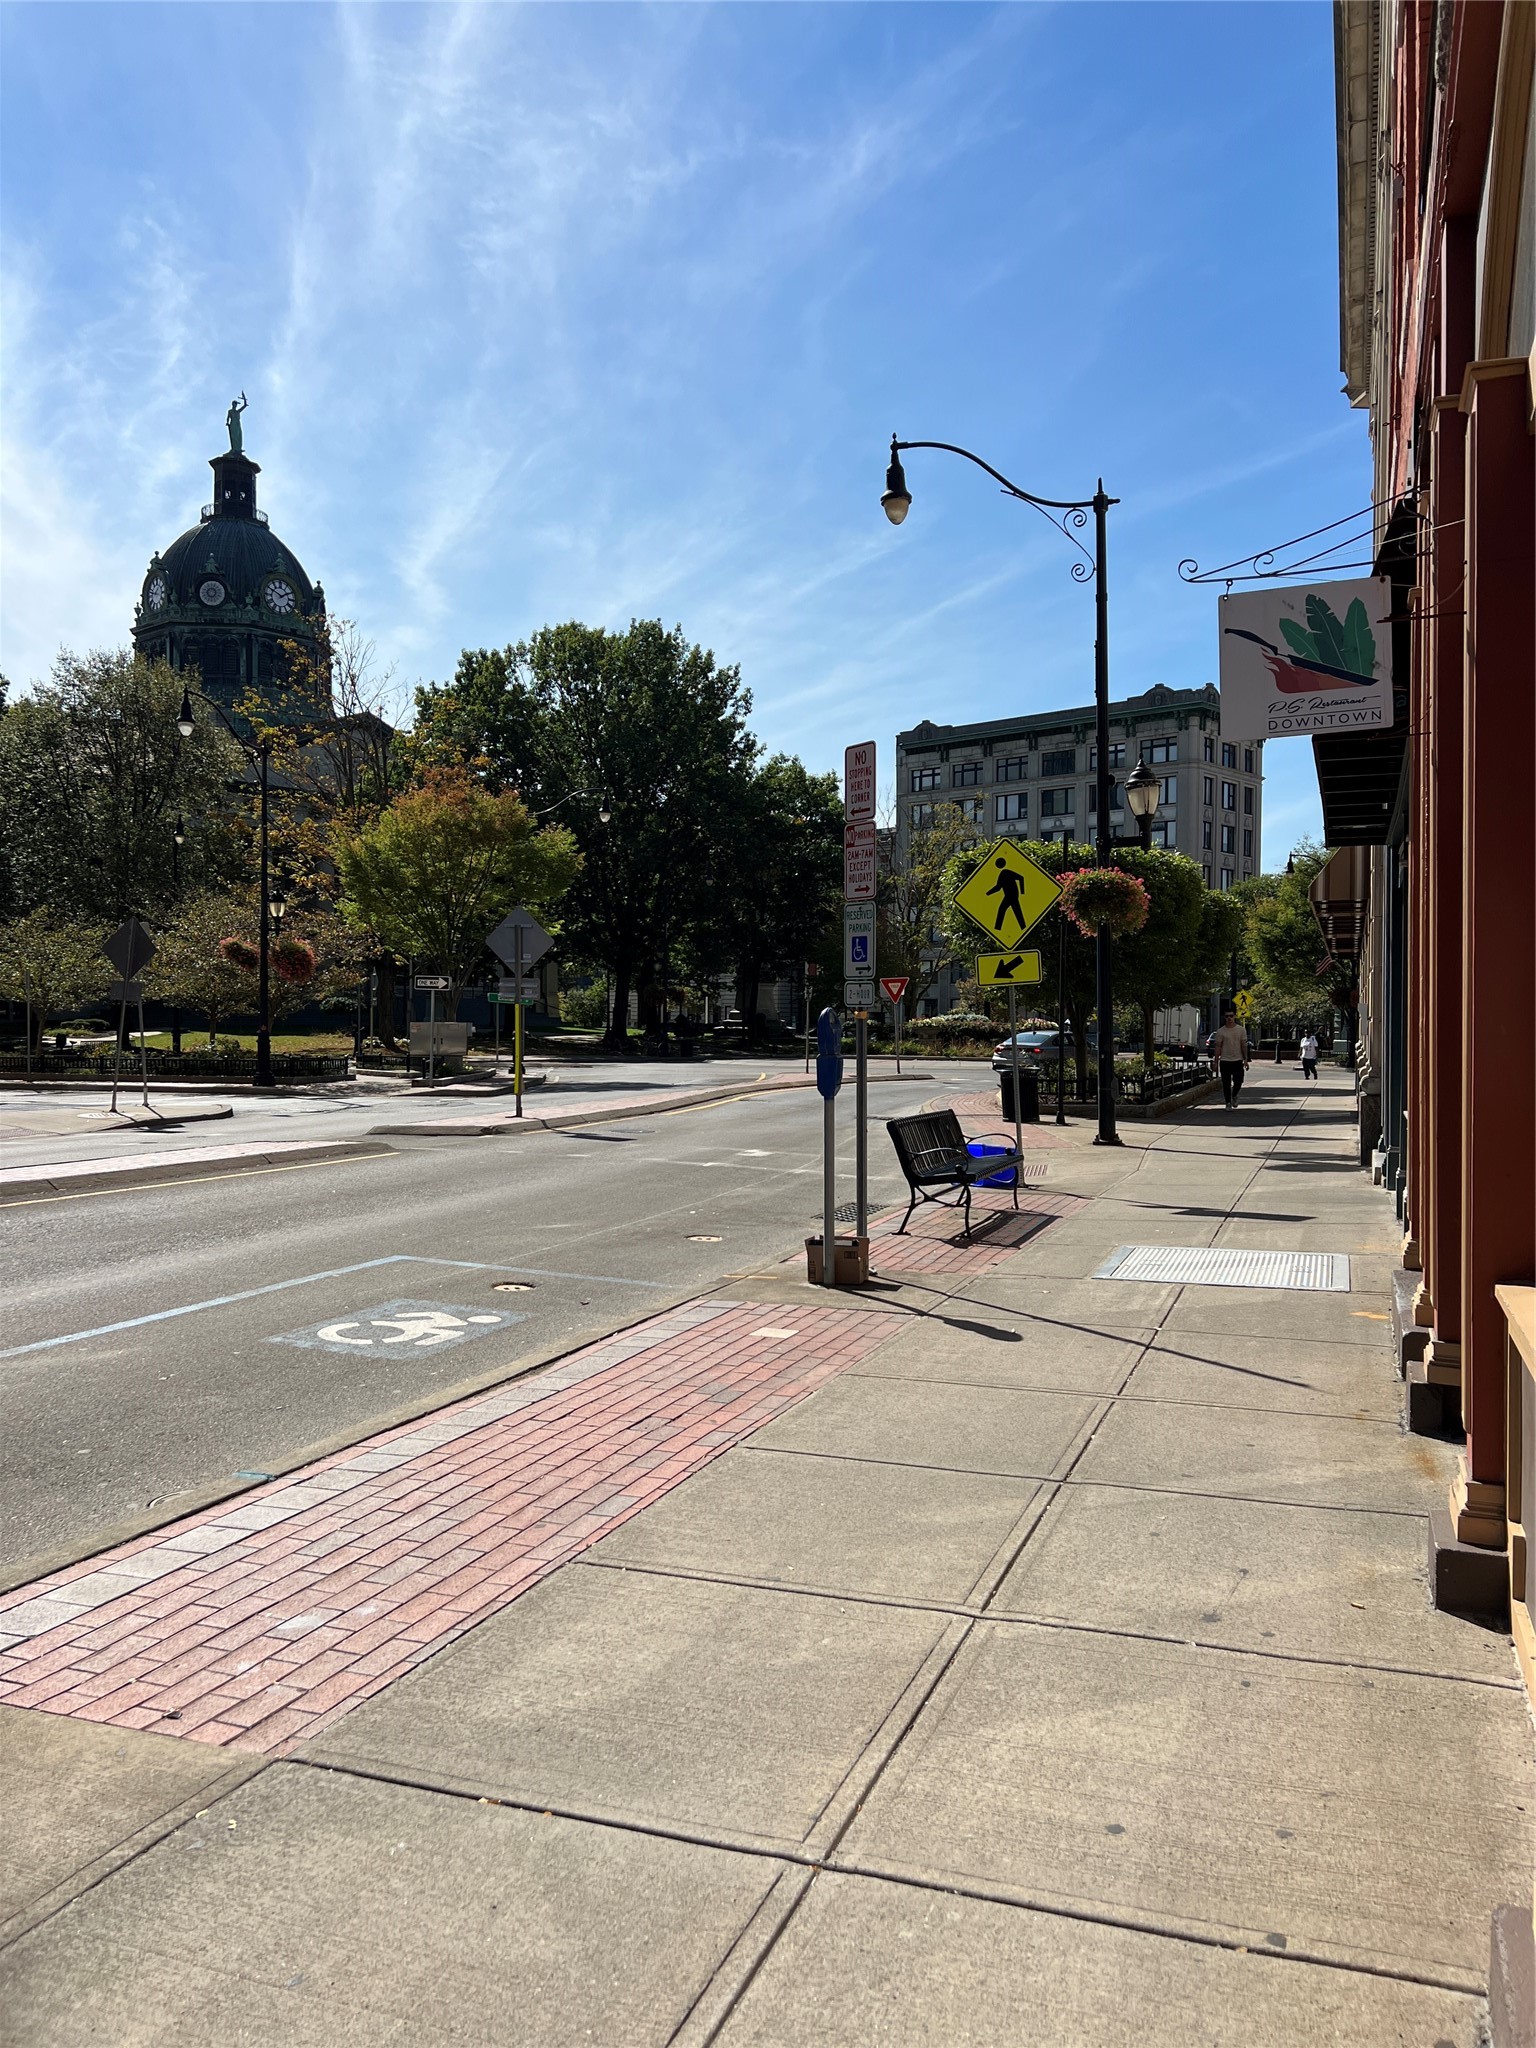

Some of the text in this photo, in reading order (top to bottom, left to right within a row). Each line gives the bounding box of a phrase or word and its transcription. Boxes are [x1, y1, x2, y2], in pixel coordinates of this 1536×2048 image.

[1268, 696, 1373, 714] P.S. Restaurant
[1268, 710, 1382, 730] DOWNTOWN
[855, 750, 867, 766] NO
[849, 765, 872, 780] STOPPING
[850, 779, 870, 792] HERE TO
[850, 792, 870, 804] CORNER
[846, 828, 874, 844] NO PARKING
[847, 848, 874, 861] 2AM-7AM
[849, 860, 871, 872] EXCEPT
[848, 872, 873, 883] HOLIDAYS
[846, 909, 873, 920] RESERVED
[848, 922, 872, 933] PARKING
[418, 979, 428, 987] ONE
[849, 989, 870, 999] 2-HOUR
